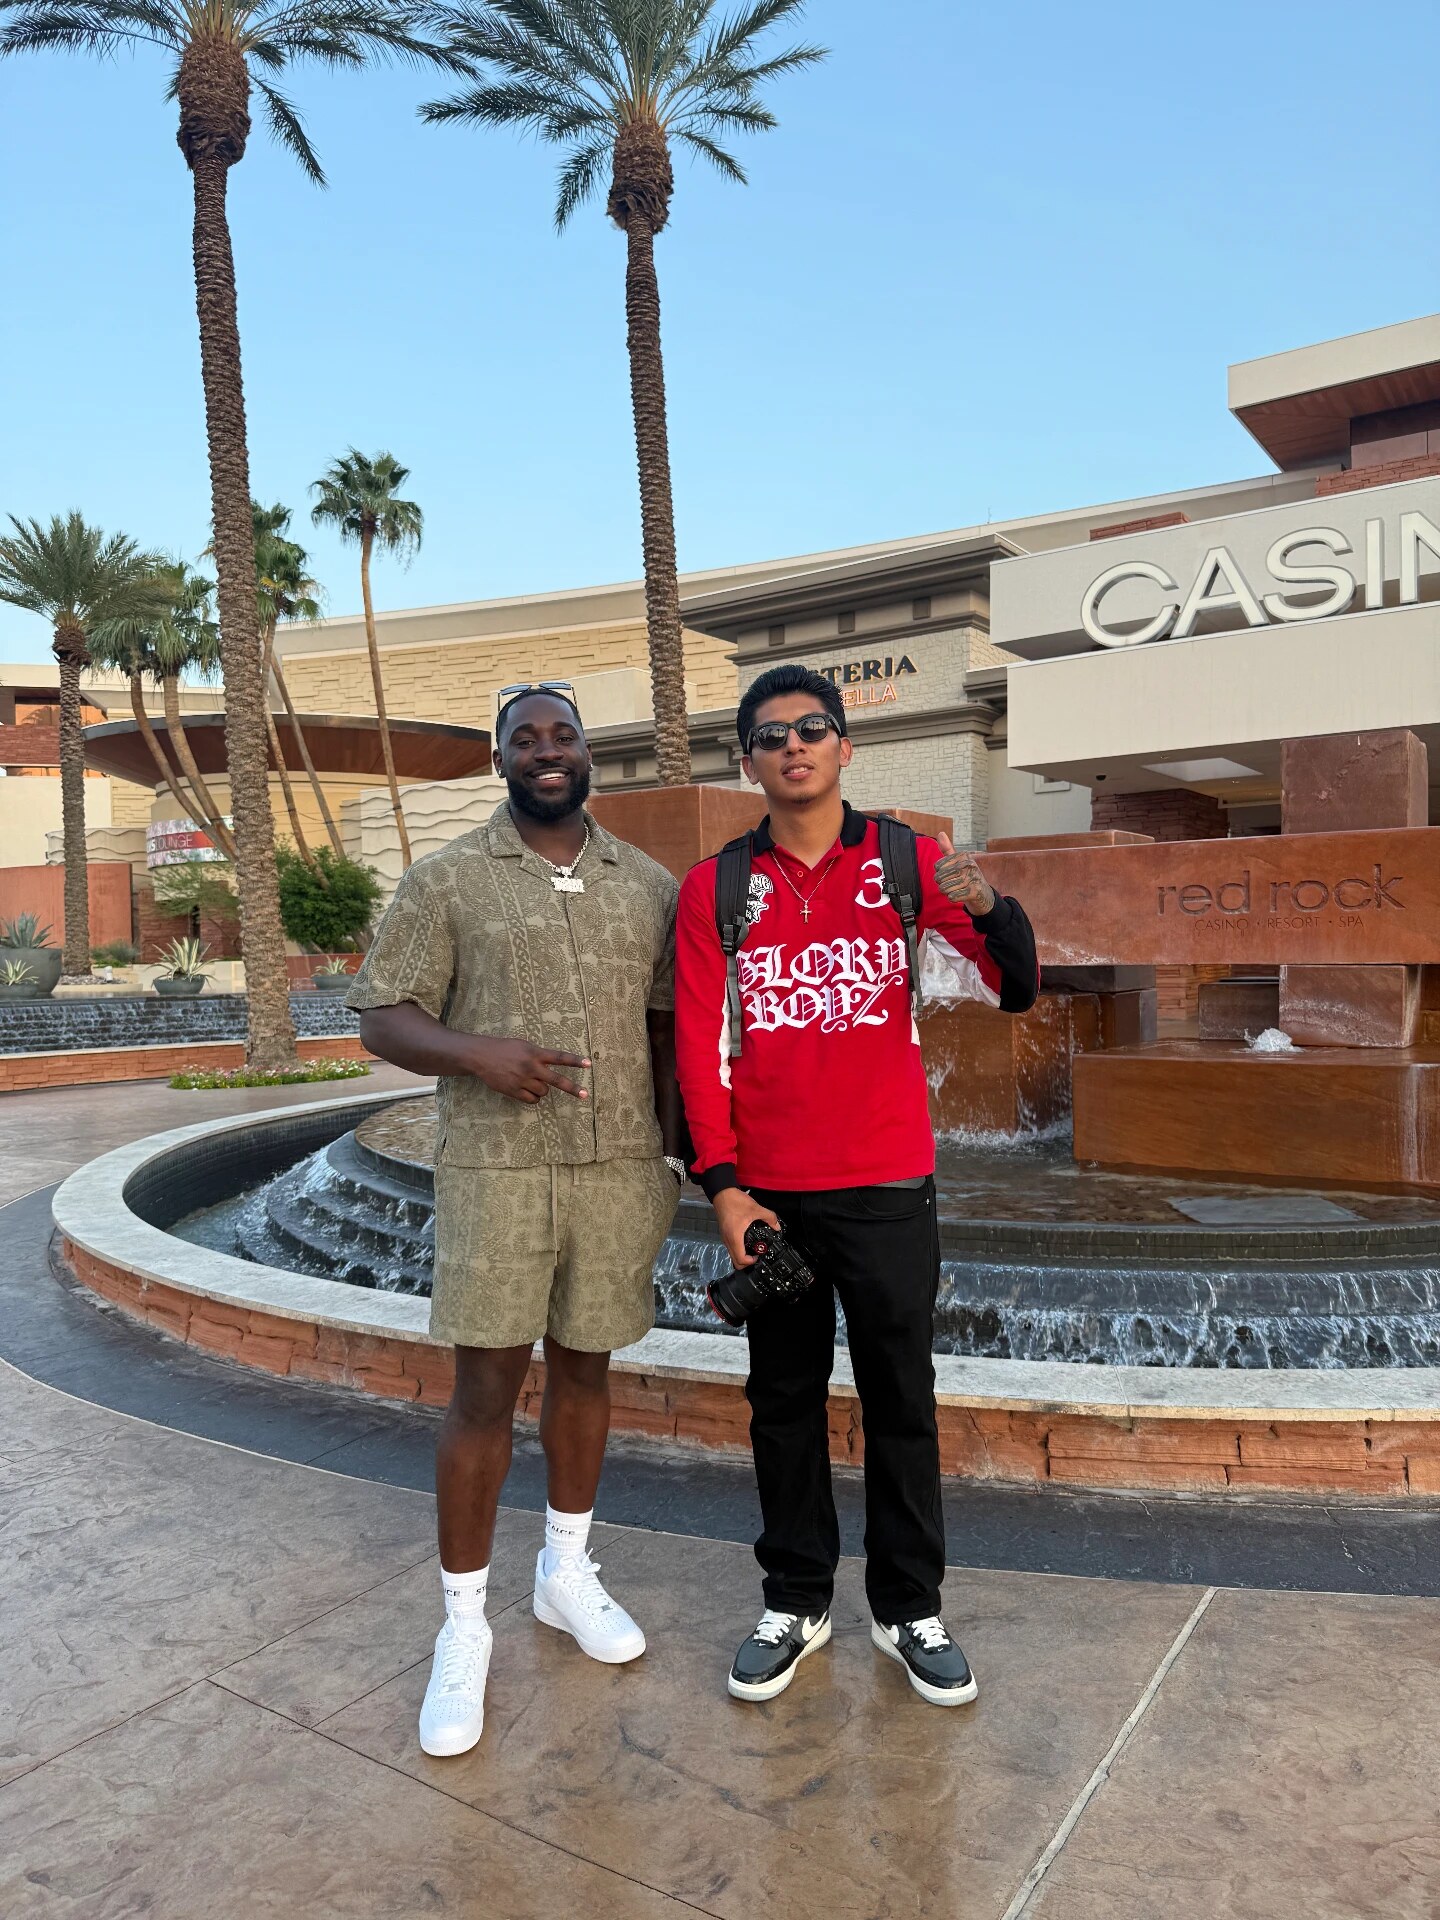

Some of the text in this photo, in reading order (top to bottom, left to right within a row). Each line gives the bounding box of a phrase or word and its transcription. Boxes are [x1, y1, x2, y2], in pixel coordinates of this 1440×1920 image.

[812, 655, 917, 684] TERIA
[1157, 864, 1406, 915] red rock
[1194, 915, 1364, 931] CASINO RESORT SPA
[743, 981, 889, 1033] BOYZ
